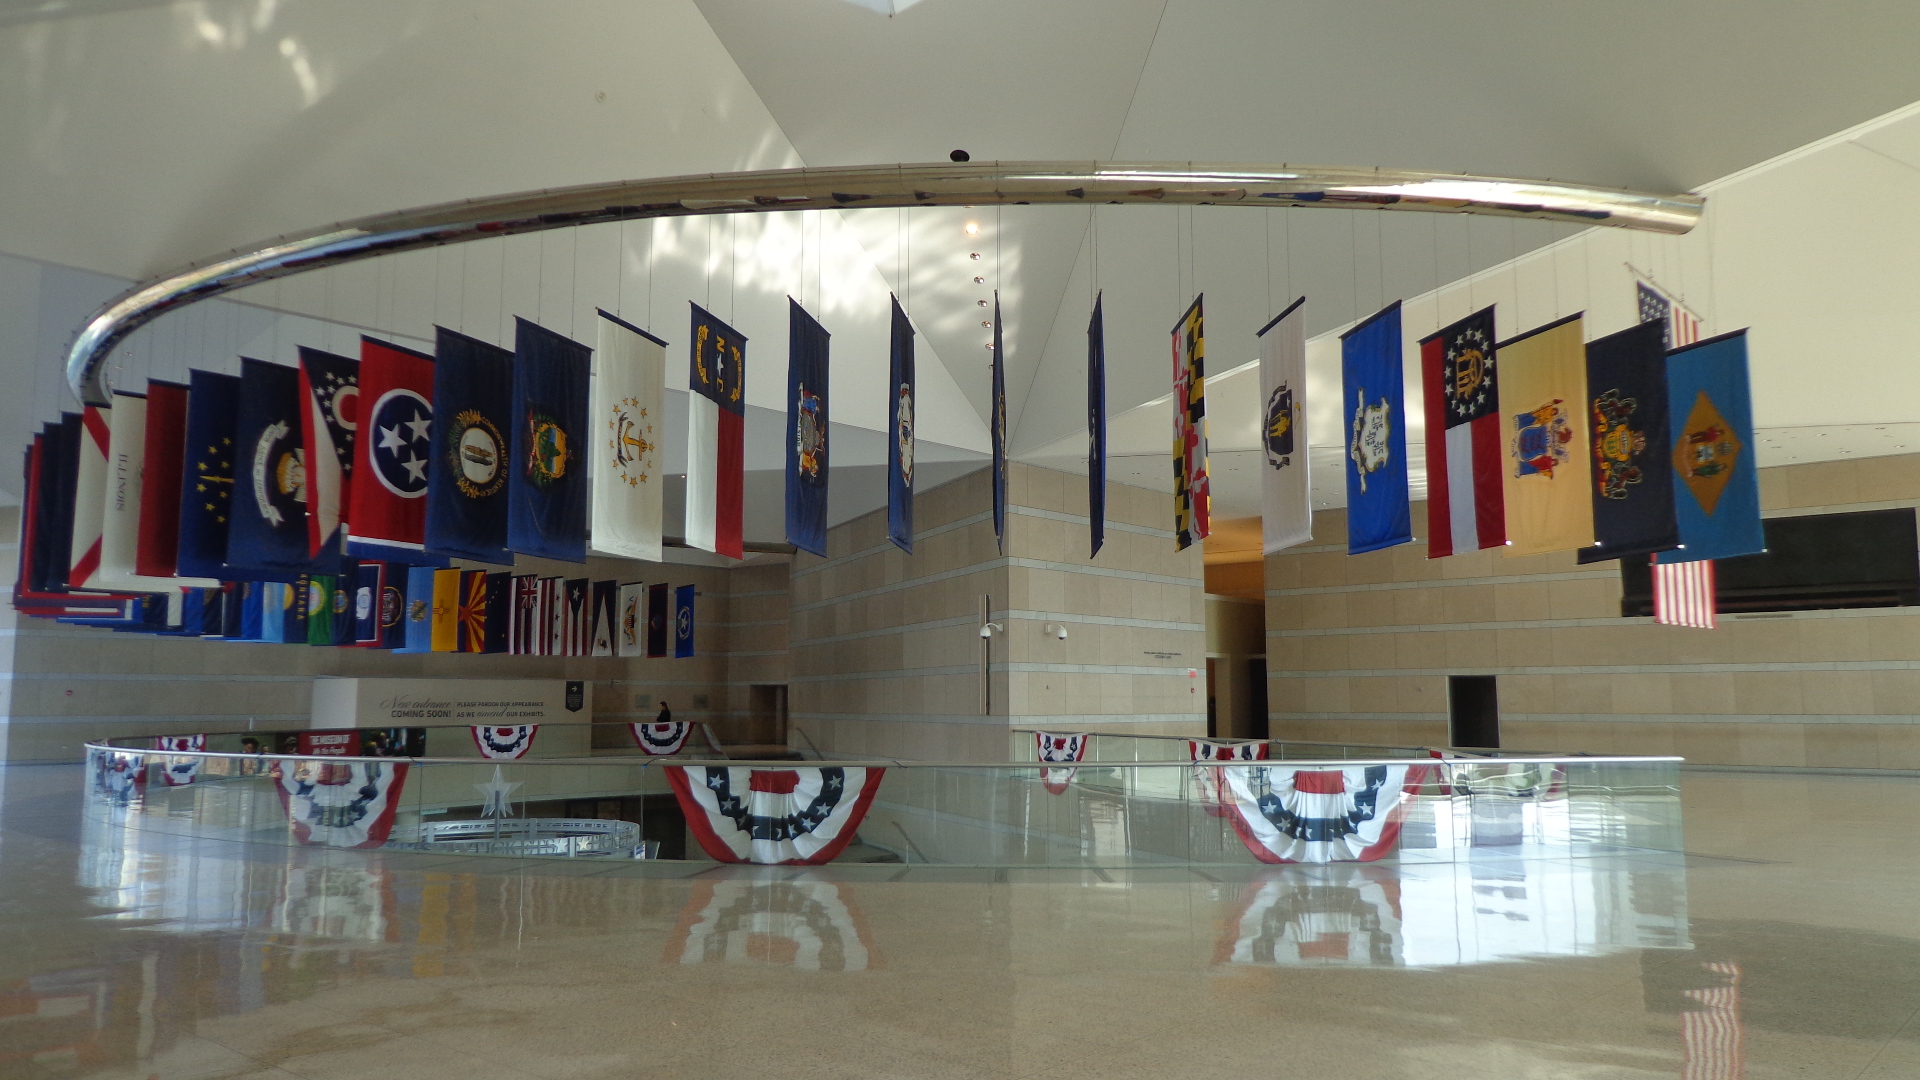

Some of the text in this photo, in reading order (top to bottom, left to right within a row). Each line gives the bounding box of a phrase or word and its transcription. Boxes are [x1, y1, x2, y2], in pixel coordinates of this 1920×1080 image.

[716, 335, 725, 393] N C
[114, 453, 128, 511] ILLINOIS
[380, 694, 451, 710] New entrance
[391, 710, 451, 718] COMING SOON!
[477, 706, 508, 718] amend
